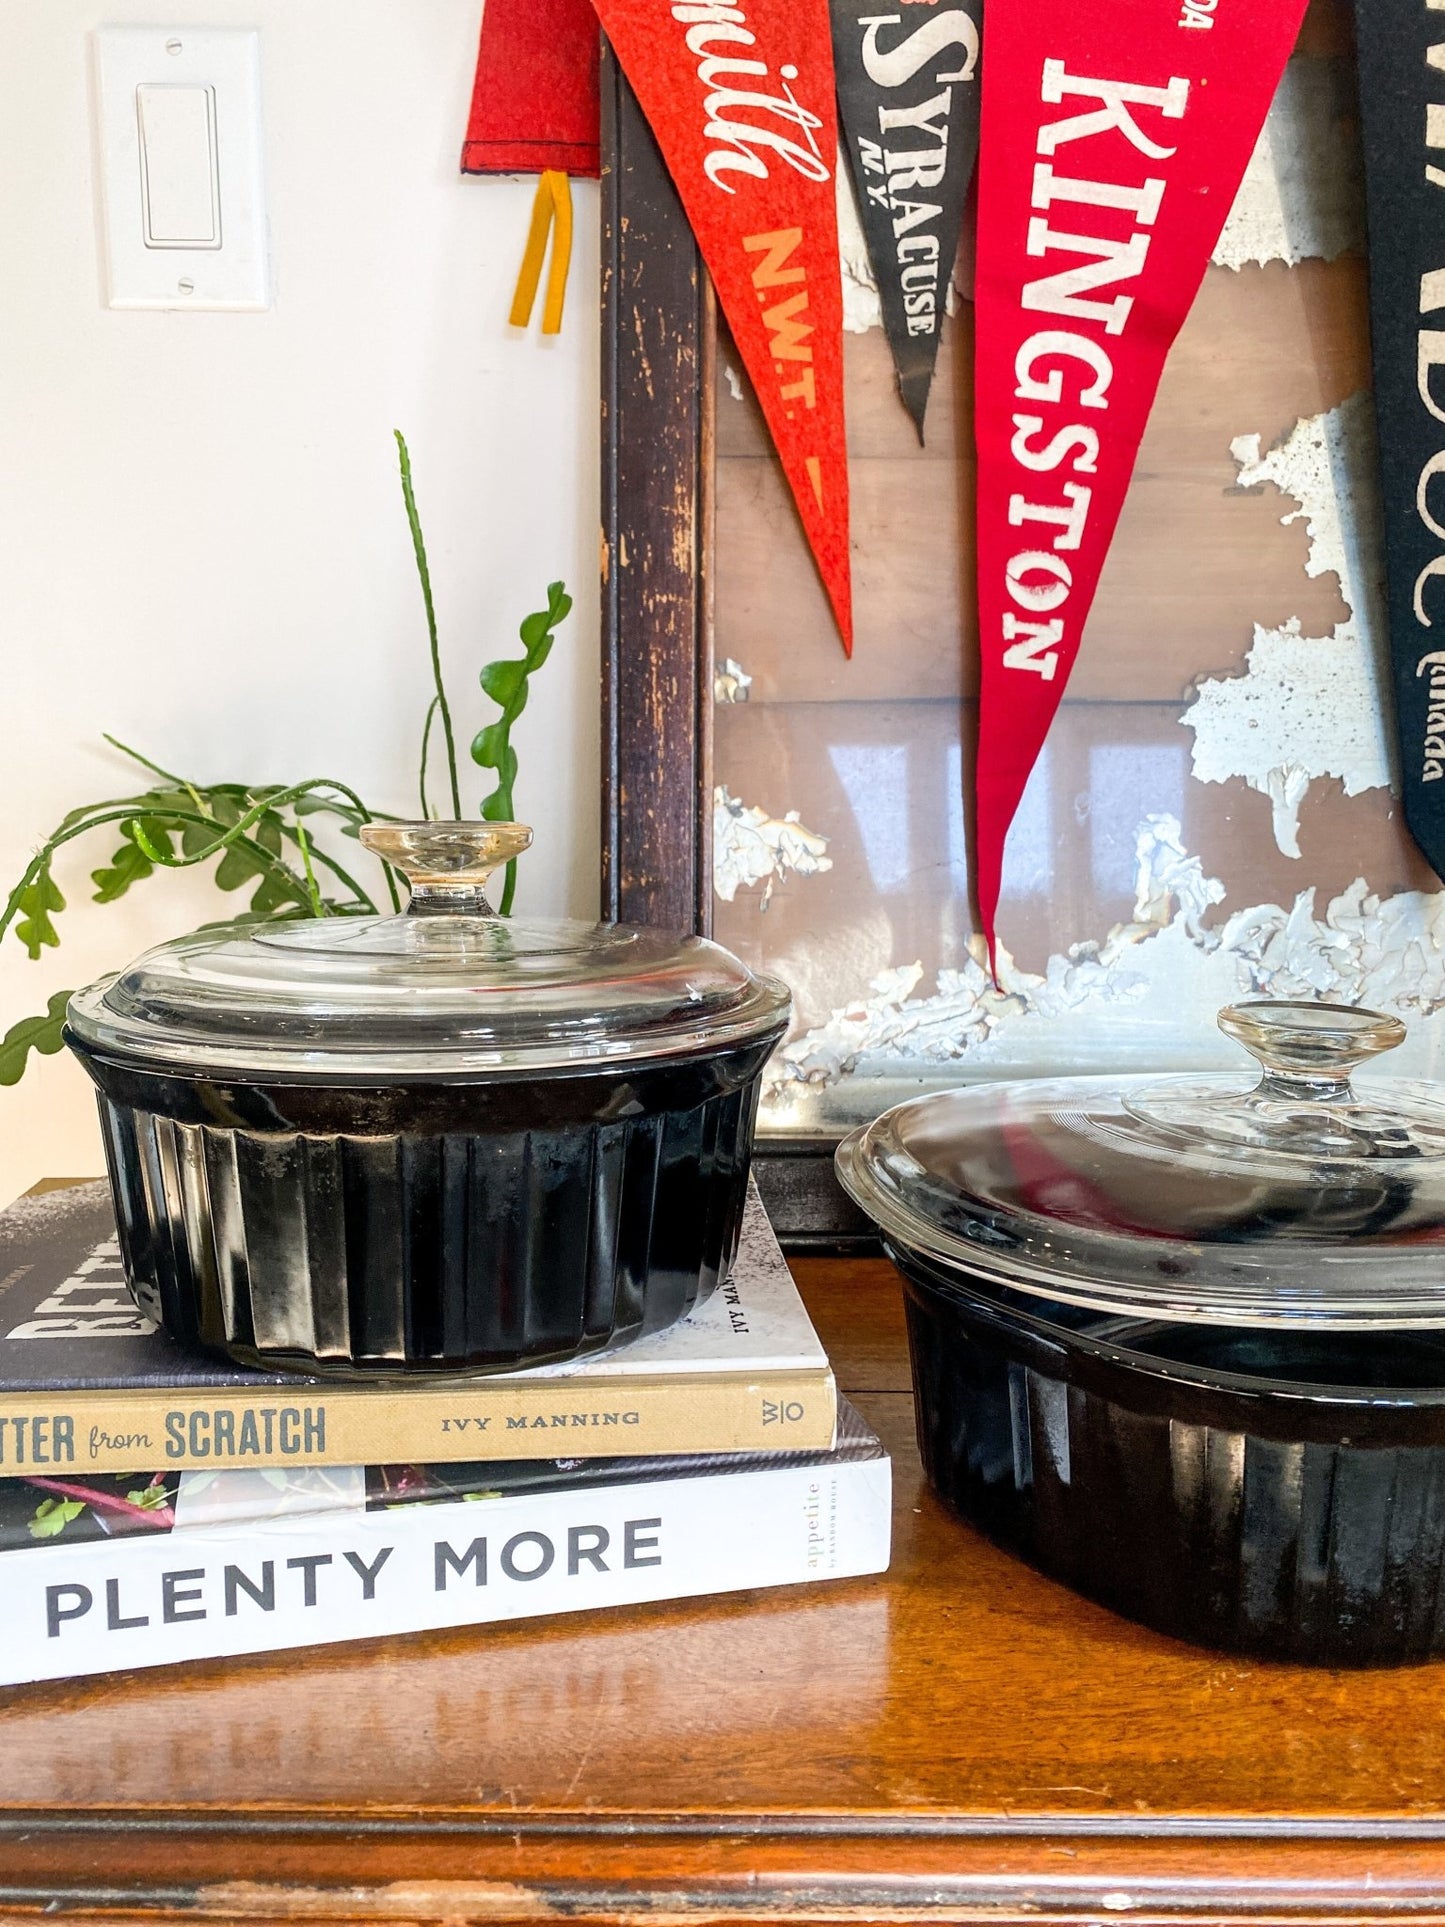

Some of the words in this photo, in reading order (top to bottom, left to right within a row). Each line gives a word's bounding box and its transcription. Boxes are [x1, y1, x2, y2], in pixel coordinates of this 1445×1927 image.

[857, 135, 890, 209] N.Y.
[857, 9, 979, 338] SYRACUSE
[742, 226, 817, 421] N.W.T.
[1002, 57, 1191, 682] KINGSTON
[728, 1310, 750, 1334] IVY
[89, 1425, 153, 1459] from
[165, 1406, 326, 1459] SCRATCH
[441, 1417, 492, 1432] IVY
[505, 1411, 640, 1430] MANNING
[803, 1483, 824, 1568] appetite
[45, 1546, 395, 1638] PLENTY
[434, 1517, 662, 1592] MORE
